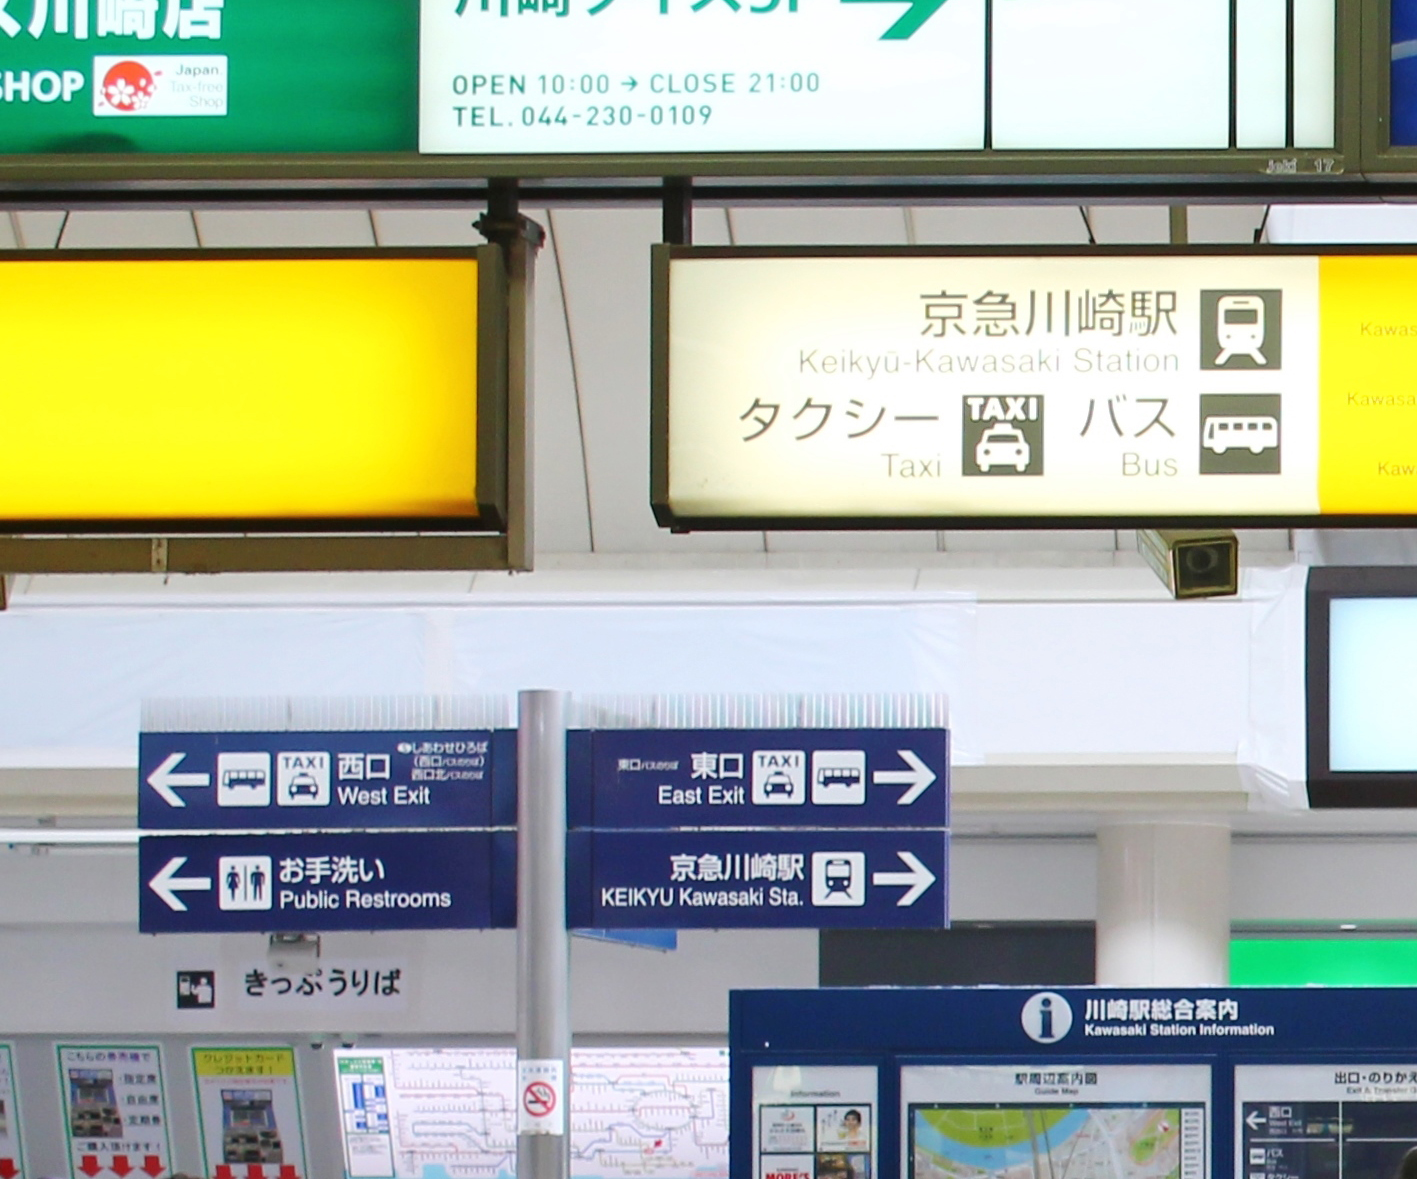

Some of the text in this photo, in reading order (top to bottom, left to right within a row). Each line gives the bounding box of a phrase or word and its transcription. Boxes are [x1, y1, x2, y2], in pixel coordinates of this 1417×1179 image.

[0, 0, 224, 39] 川崎店
[176, 64, 223, 77] Japan.
[0, 71, 84, 102] HOP
[170, 82, 223, 93] Tax-free
[453, 73, 820, 95] OPEN 10:00 CLOSE 21:00
[189, 96, 223, 109] Shop
[920, 289, 1178, 338] 京急川崎駅
[1074, 348, 1179, 373] Station
[739, 397, 940, 443] タクシー
[967, 397, 1039, 422] TAXI
[1080, 396, 1177, 440] バス
[882, 453, 942, 478] Taxi
[1122, 453, 1178, 478] Bus
[283, 756, 325, 769] TAXI
[337, 753, 391, 781] 西口
[691, 752, 745, 780] 東口
[758, 755, 800, 768] TAXI
[337, 785, 431, 805] West Exit
[658, 785, 745, 805] East Exit
[279, 856, 386, 884] お手洗い
[670, 853, 804, 882] 京急川崎駅
[279, 890, 452, 909] Public Restrooms
[601, 887, 804, 907] KEIKYU Kawasaki Sta.
[244, 968, 402, 997] きっぷうりば
[1084, 998, 1239, 1022] 川崎駅総合案内
[1084, 1023, 1275, 1037] Kawasaki Station Information
[1014, 1072, 1097, 1086] 駅周辺案内図
[791, 1090, 840, 1098] Information
[1035, 1087, 1079, 1097] Guide Map
[1268, 1106, 1292, 1118] 西口
